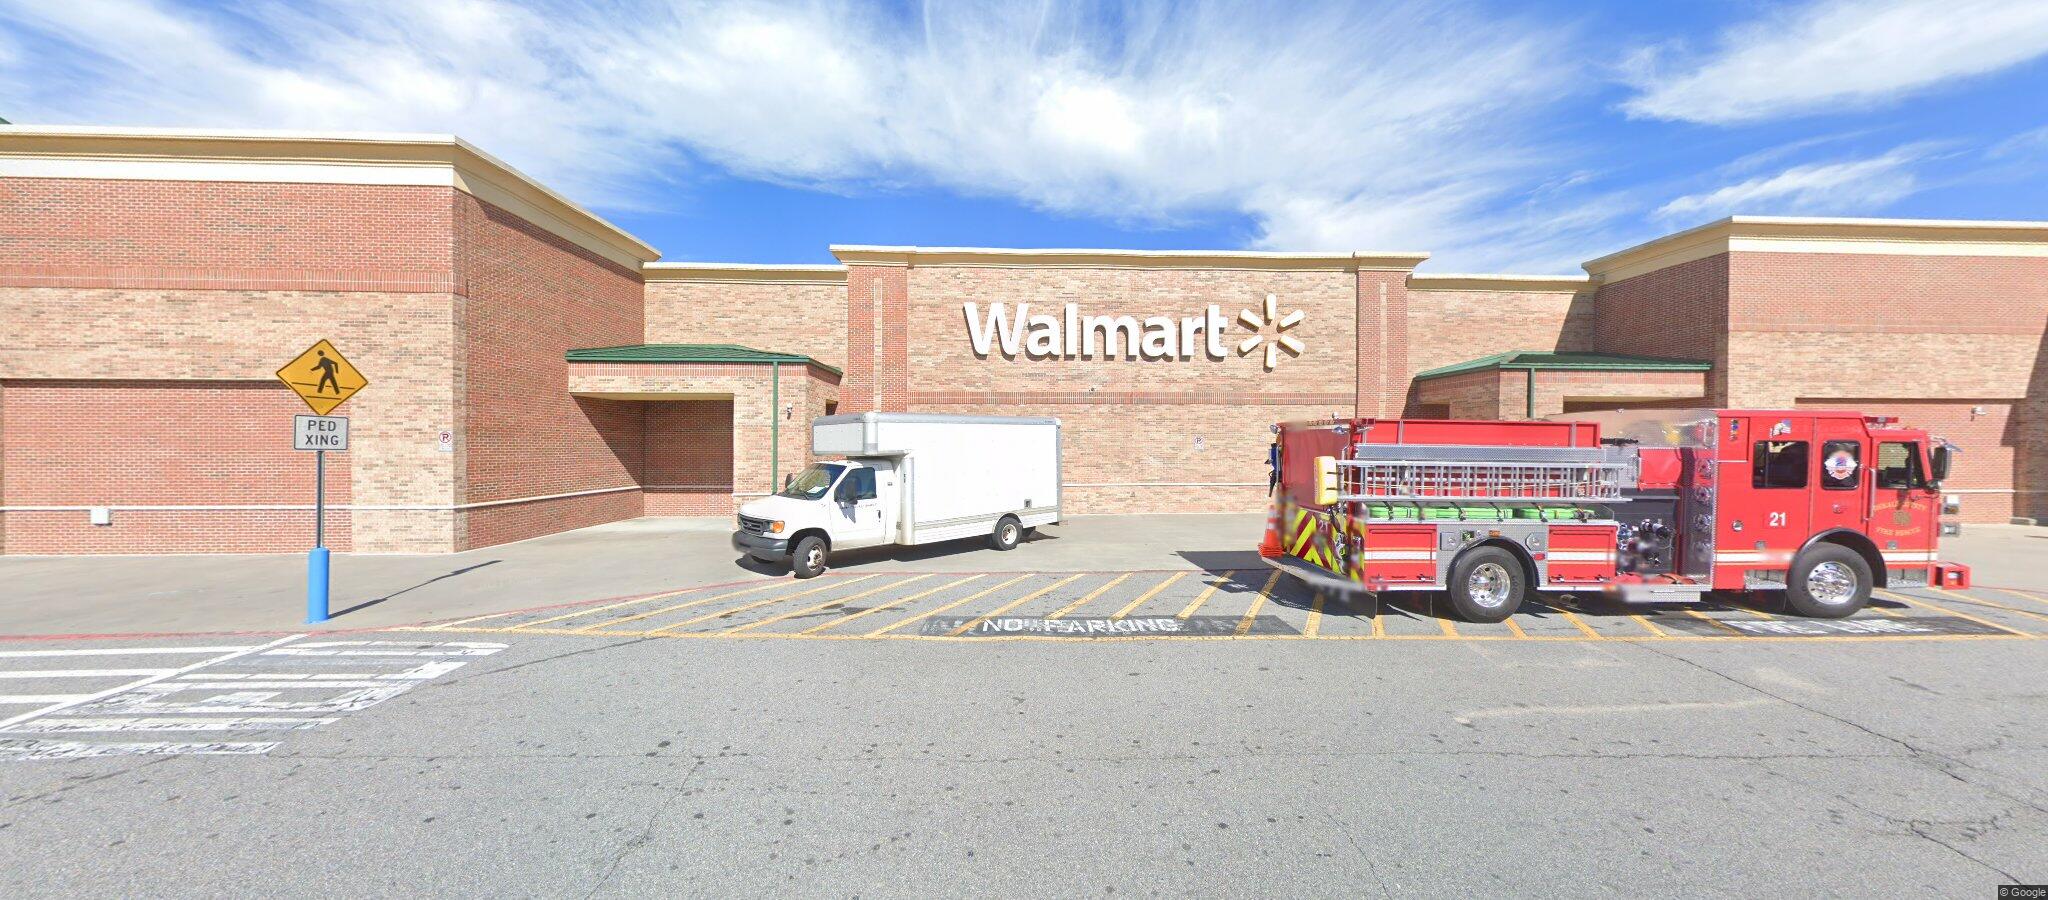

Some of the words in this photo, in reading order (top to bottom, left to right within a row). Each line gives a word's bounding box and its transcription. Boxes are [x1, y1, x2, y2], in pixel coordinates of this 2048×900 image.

[963, 302, 1228, 359] Walmart
[307, 419, 336, 431] PED
[305, 434, 339, 446] XING
[1769, 511, 1786, 527] 21
[982, 618, 1023, 632] NO
[1044, 618, 1182, 633] PARKING
